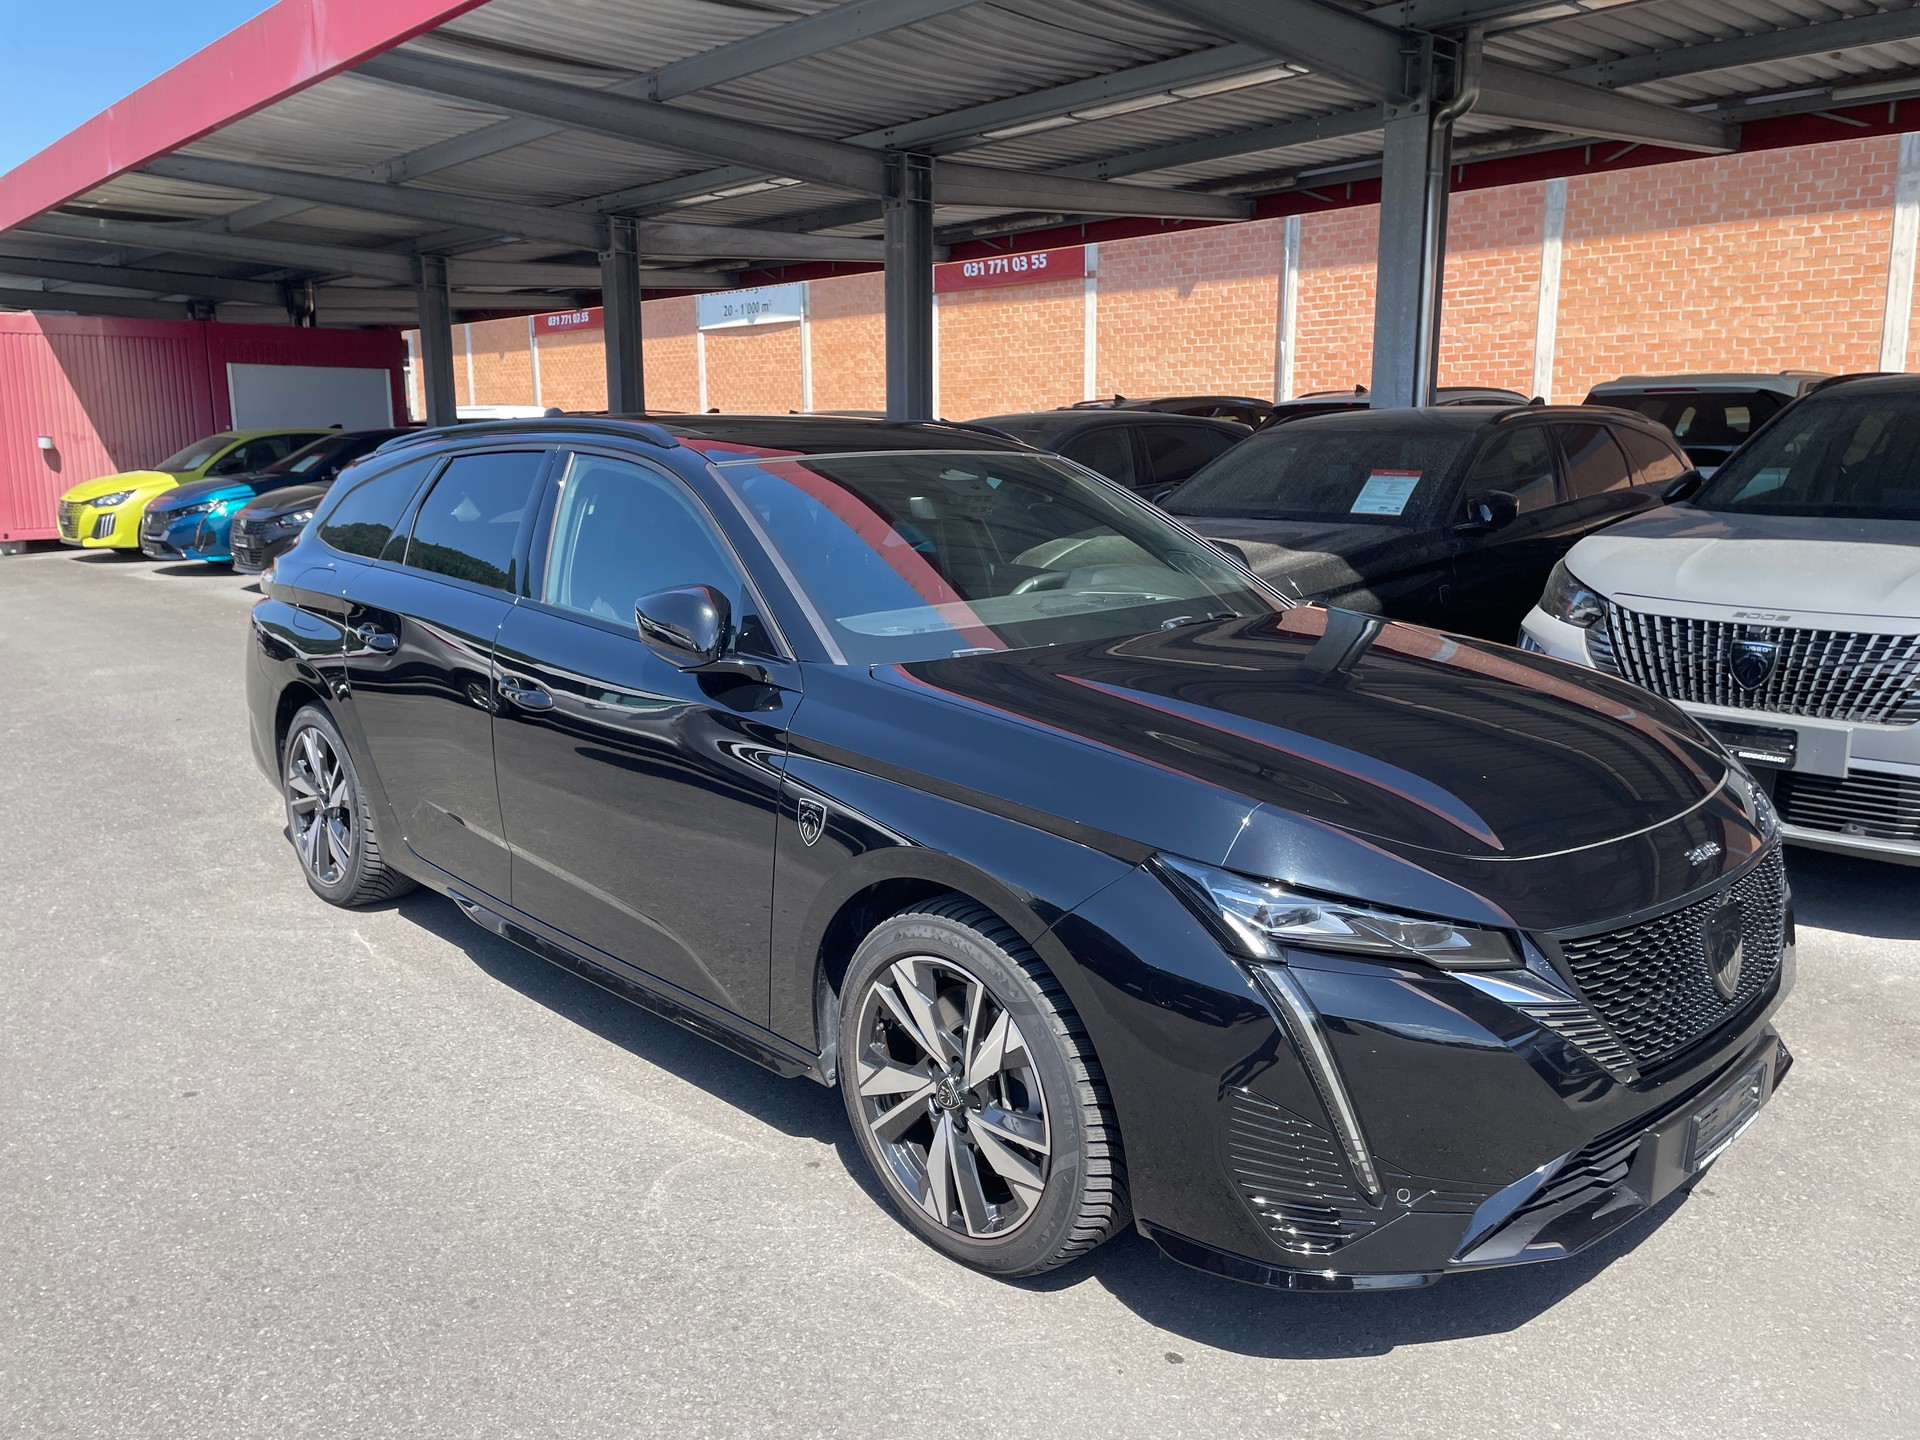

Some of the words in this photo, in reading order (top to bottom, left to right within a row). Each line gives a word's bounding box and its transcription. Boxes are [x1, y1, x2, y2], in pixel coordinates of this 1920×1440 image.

[963, 262, 985, 277] 031
[988, 259, 1009, 275] 771
[1012, 256, 1028, 271] 03
[1031, 253, 1047, 269] 55
[547, 316, 560, 326] 031
[561, 314, 572, 325] 771
[573, 313, 580, 323] 03
[581, 311, 589, 323] 55
[724, 305, 733, 317] 20
